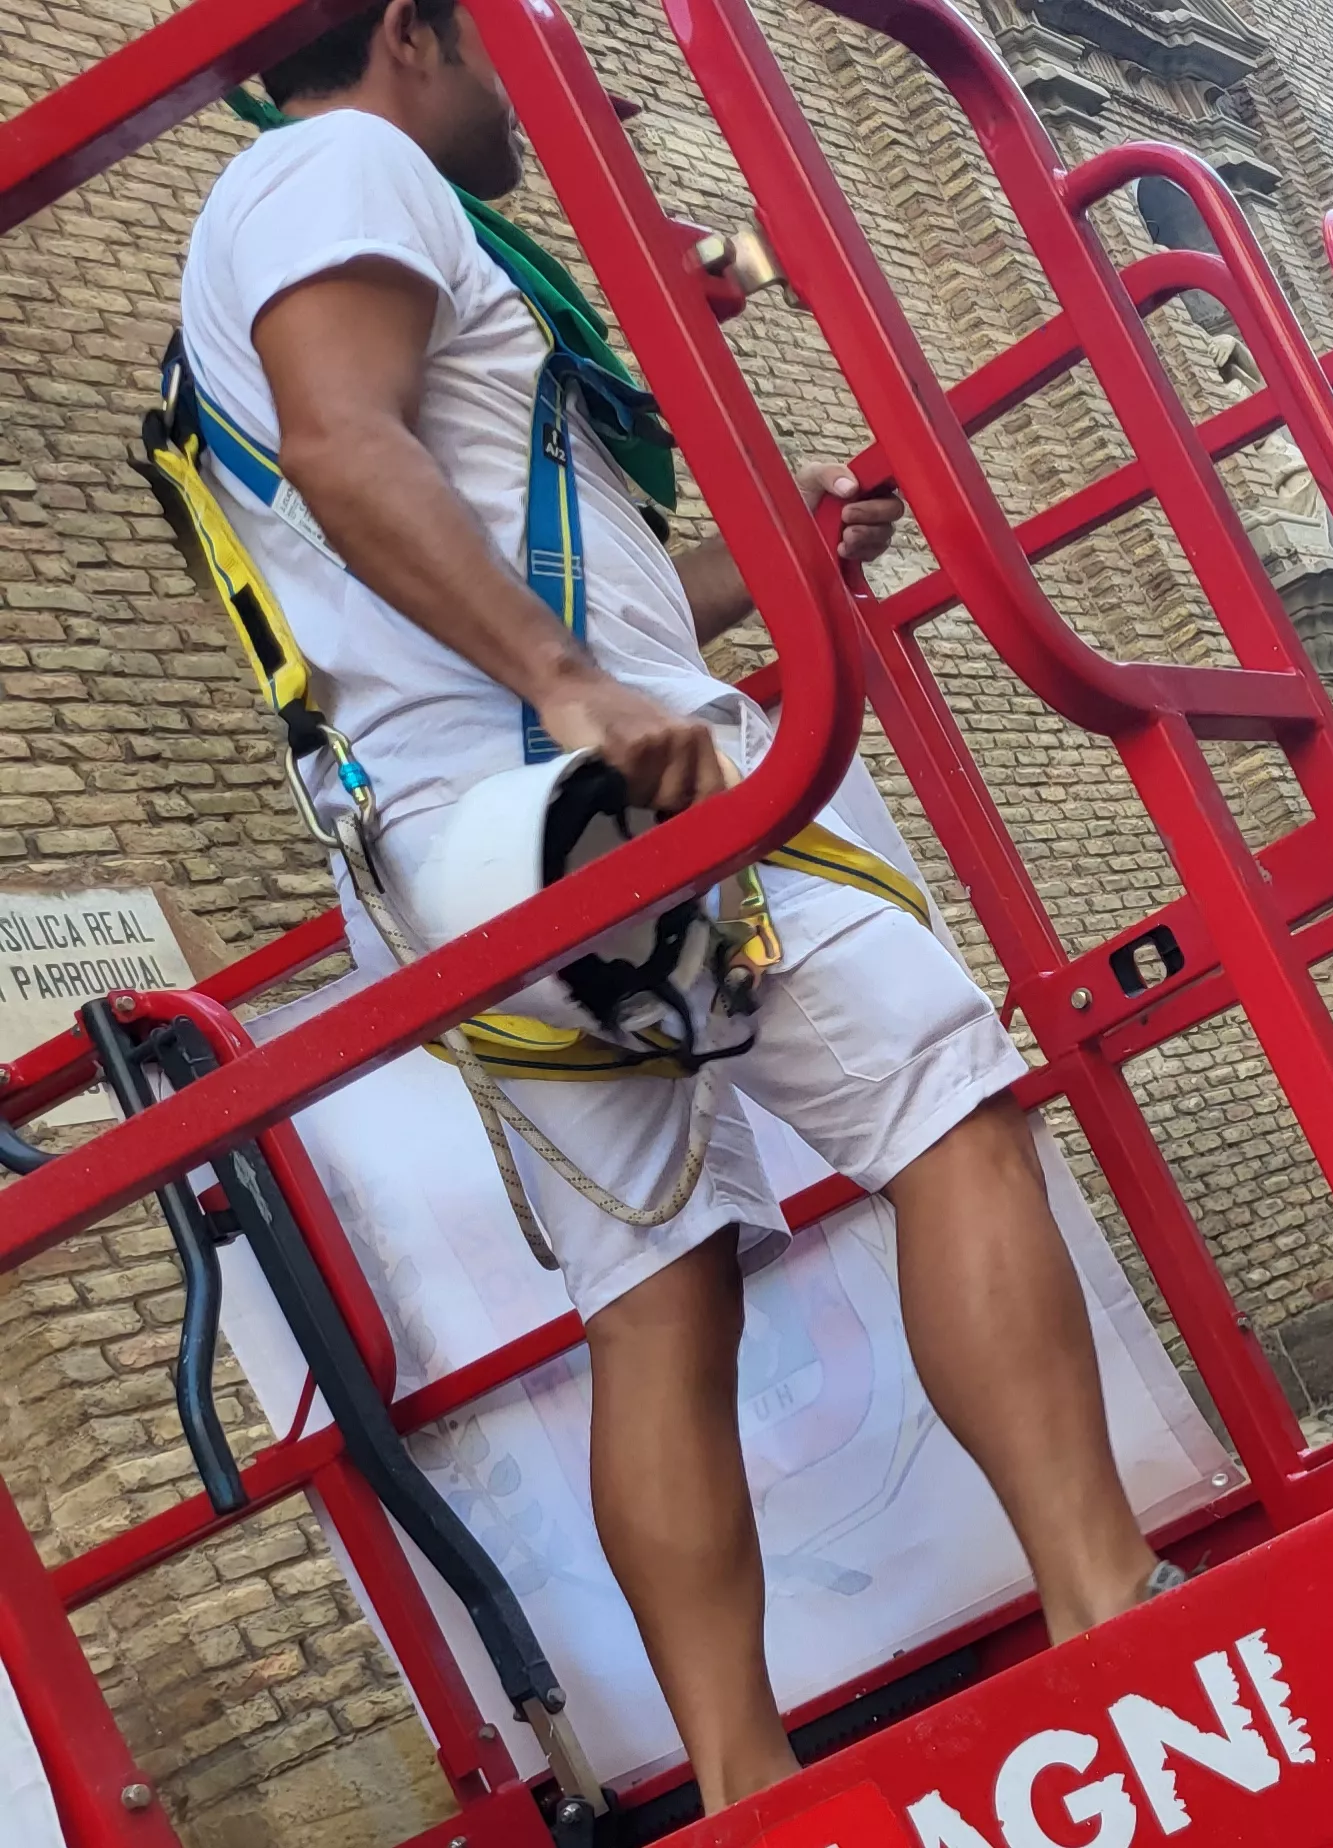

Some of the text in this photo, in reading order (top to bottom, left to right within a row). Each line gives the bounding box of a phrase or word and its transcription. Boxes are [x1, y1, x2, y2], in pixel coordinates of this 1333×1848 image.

[0, 910, 155, 952] SÍLICA REAL
[10, 954, 177, 1000] PARROQUIAL
[905, 1628, 1316, 1848] GNI
